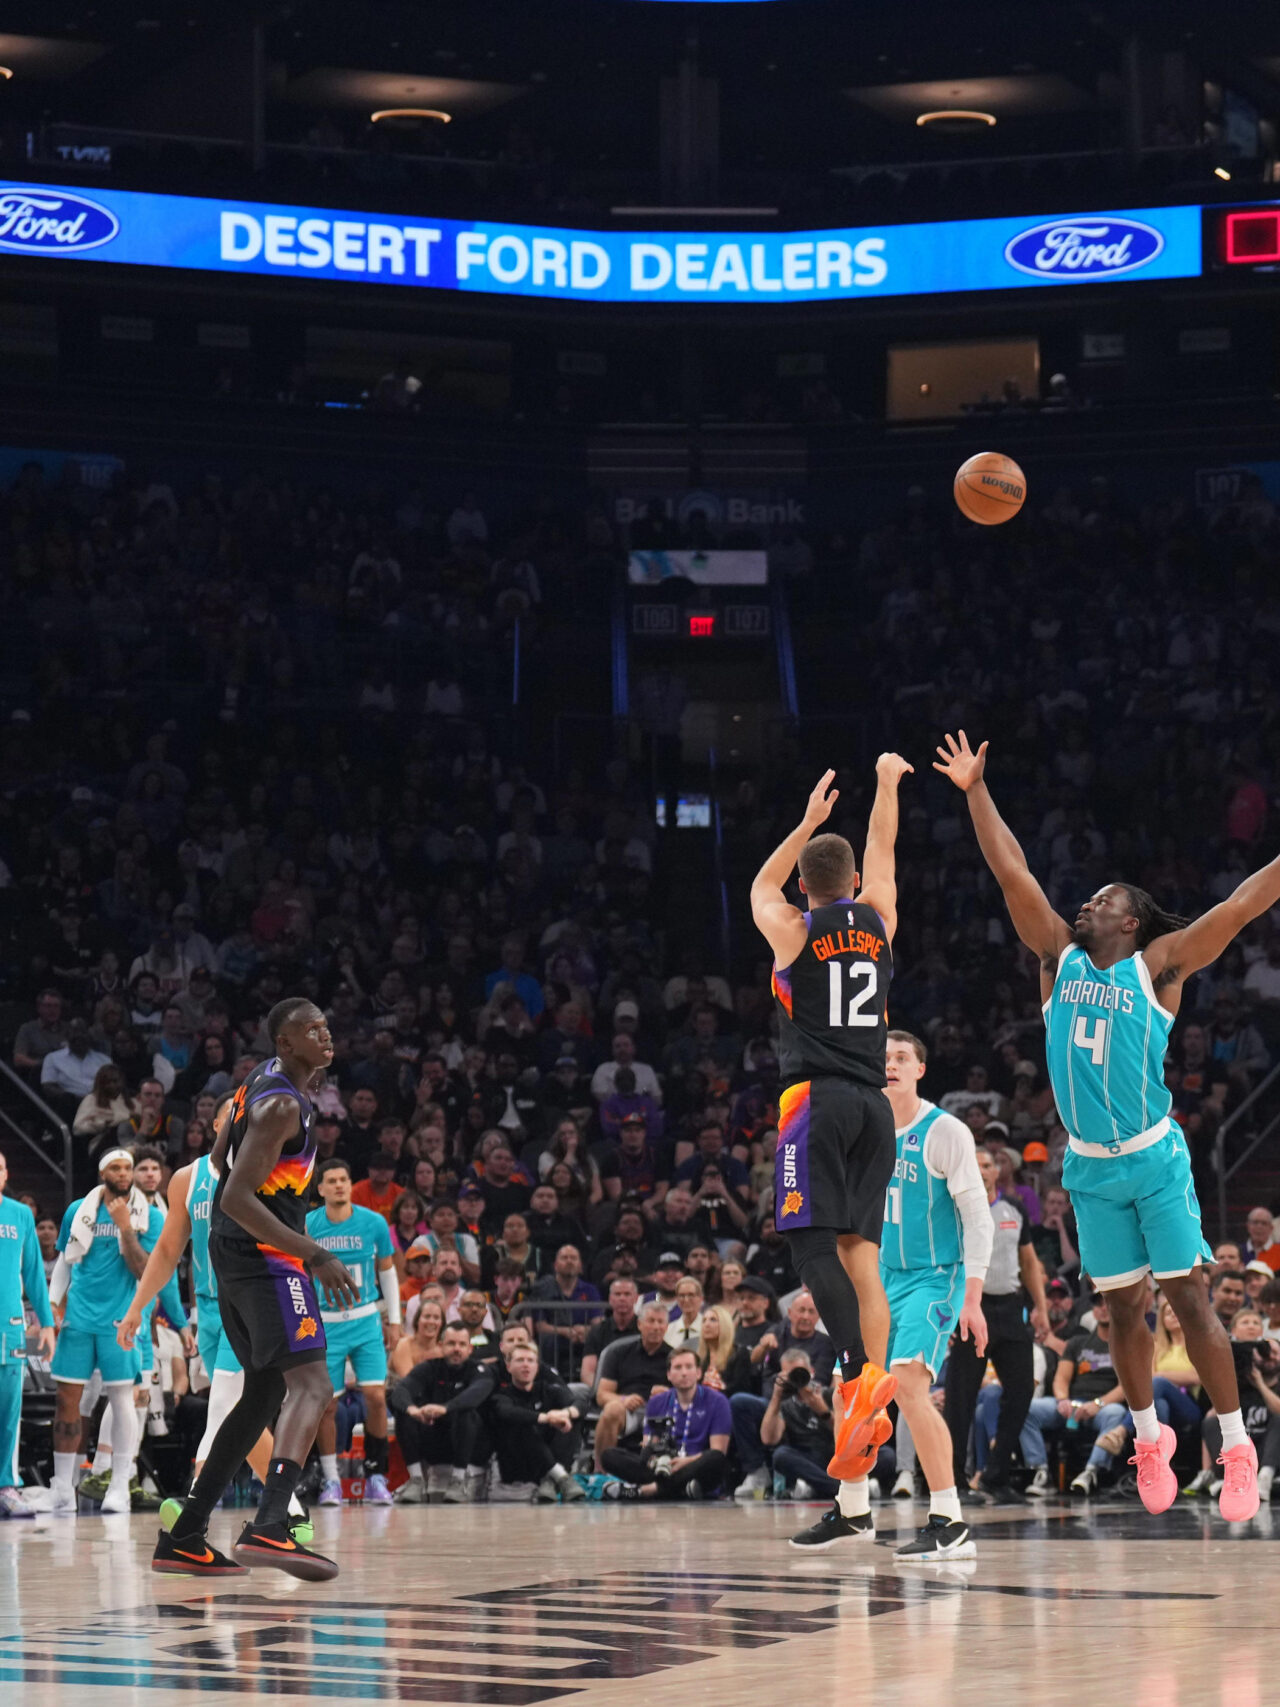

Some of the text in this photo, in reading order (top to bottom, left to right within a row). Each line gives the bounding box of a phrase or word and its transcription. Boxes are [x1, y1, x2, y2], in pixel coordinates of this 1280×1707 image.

[220, 211, 888, 291] DESERT FORD DEALERS
[1035, 226, 1134, 271] Ford
[728, 498, 804, 524] Bank
[812, 929, 885, 963] GILLESPIE
[828, 960, 879, 1028] 12
[1058, 979, 1136, 1015] HORNETS
[1073, 1015, 1107, 1066] 4
[783, 1143, 797, 1189] SUNS
[286, 1276, 309, 1316] SUNS
